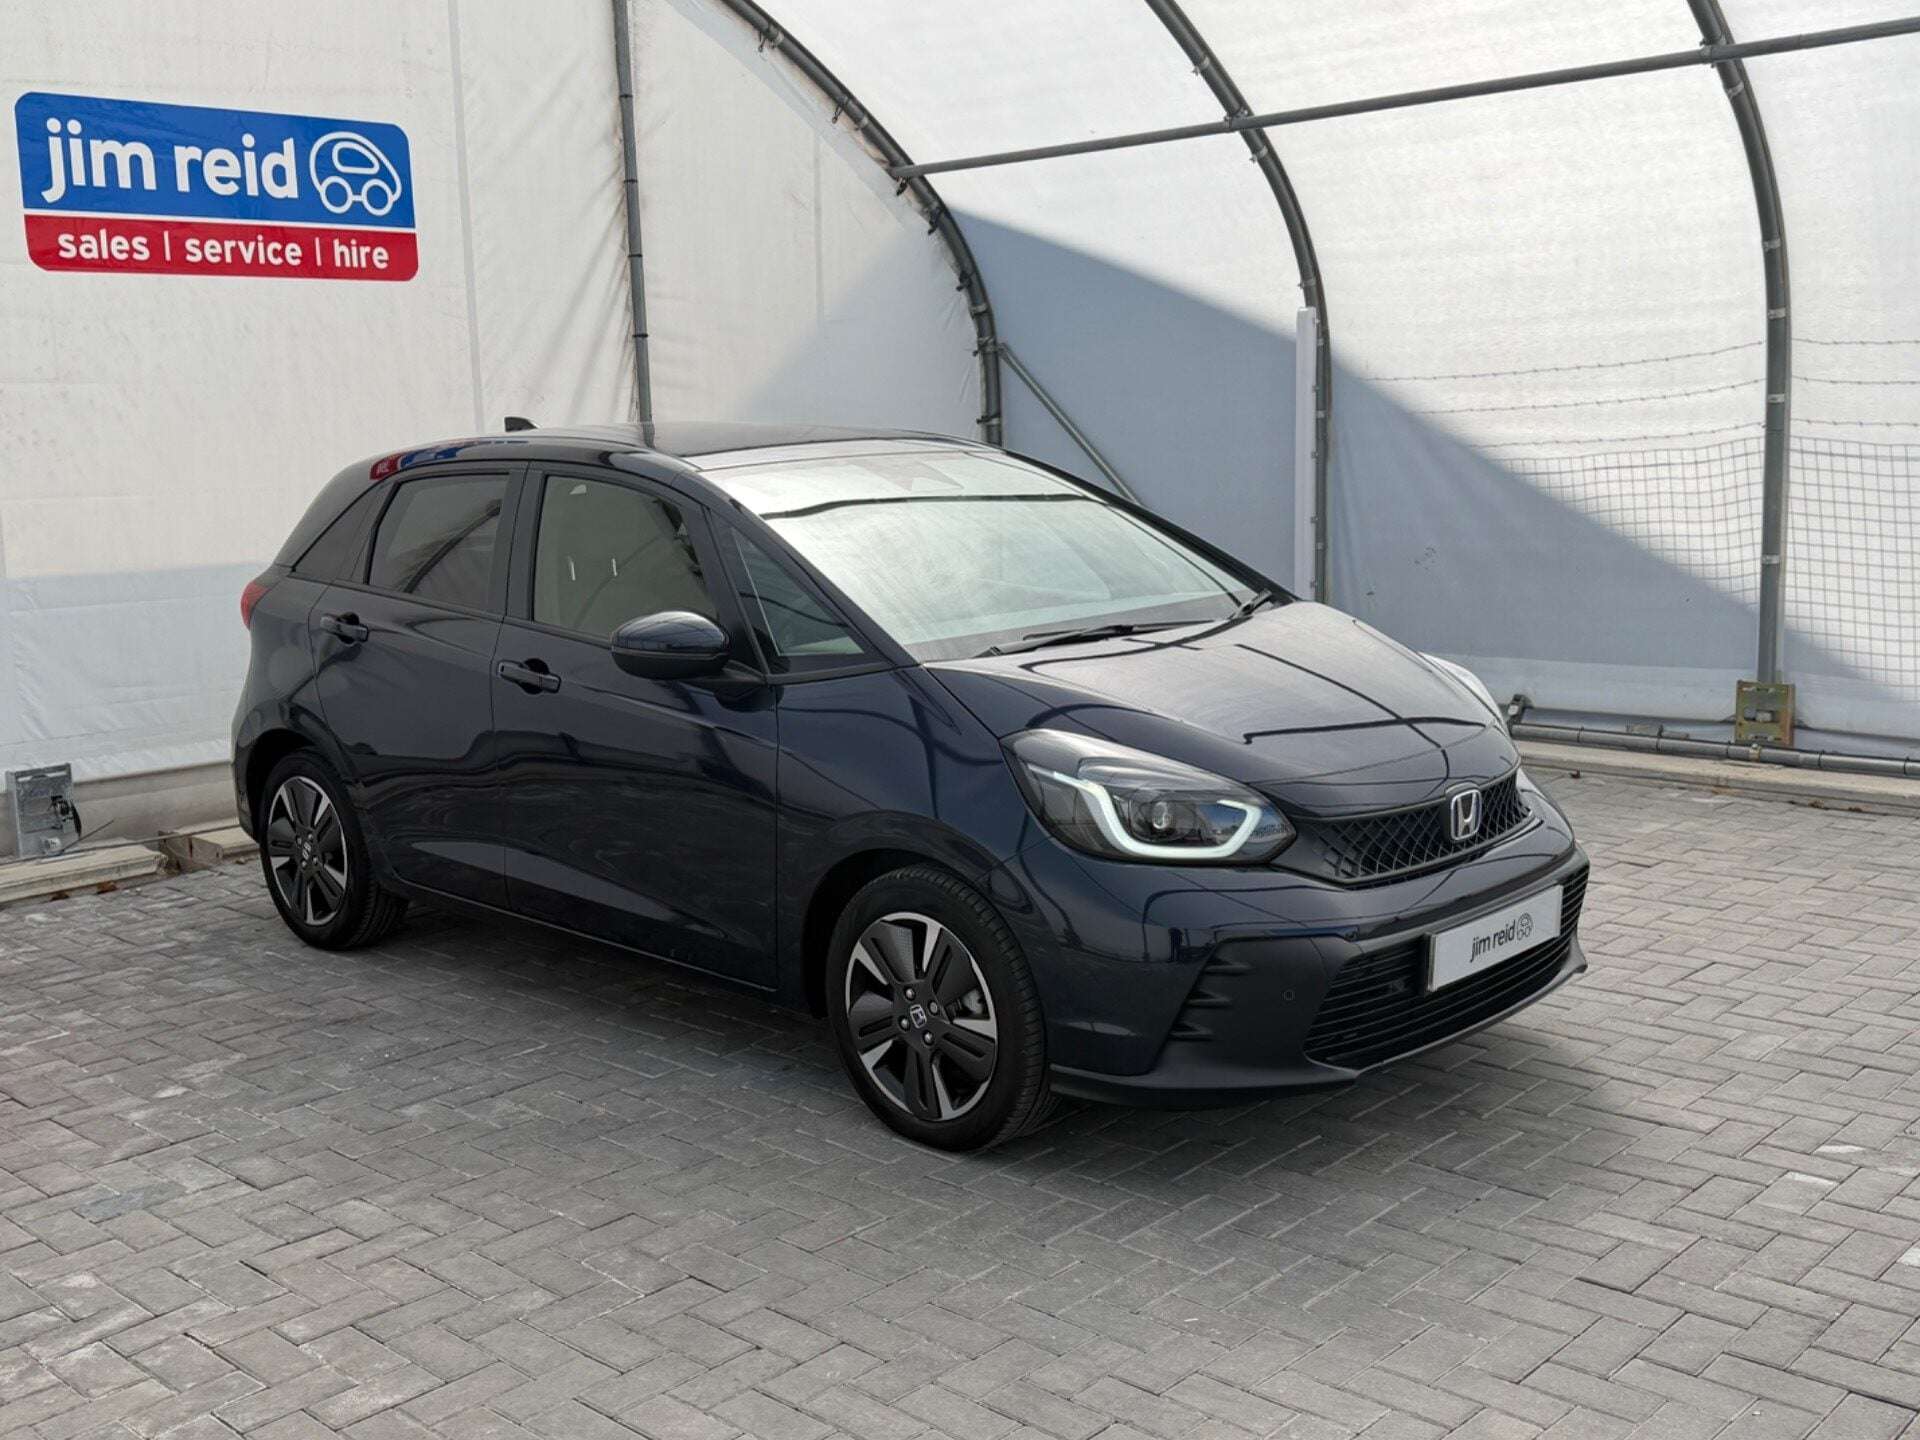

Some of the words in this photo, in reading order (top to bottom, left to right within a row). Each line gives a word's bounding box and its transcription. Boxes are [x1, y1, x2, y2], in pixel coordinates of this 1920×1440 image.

[41, 117, 157, 203] jim
[173, 133, 299, 199] reid
[57, 228, 150, 262] sales
[184, 234, 302, 266] service
[333, 238, 389, 270] hire
[1470, 934, 1491, 963] jim
[1492, 919, 1516, 948] reid
